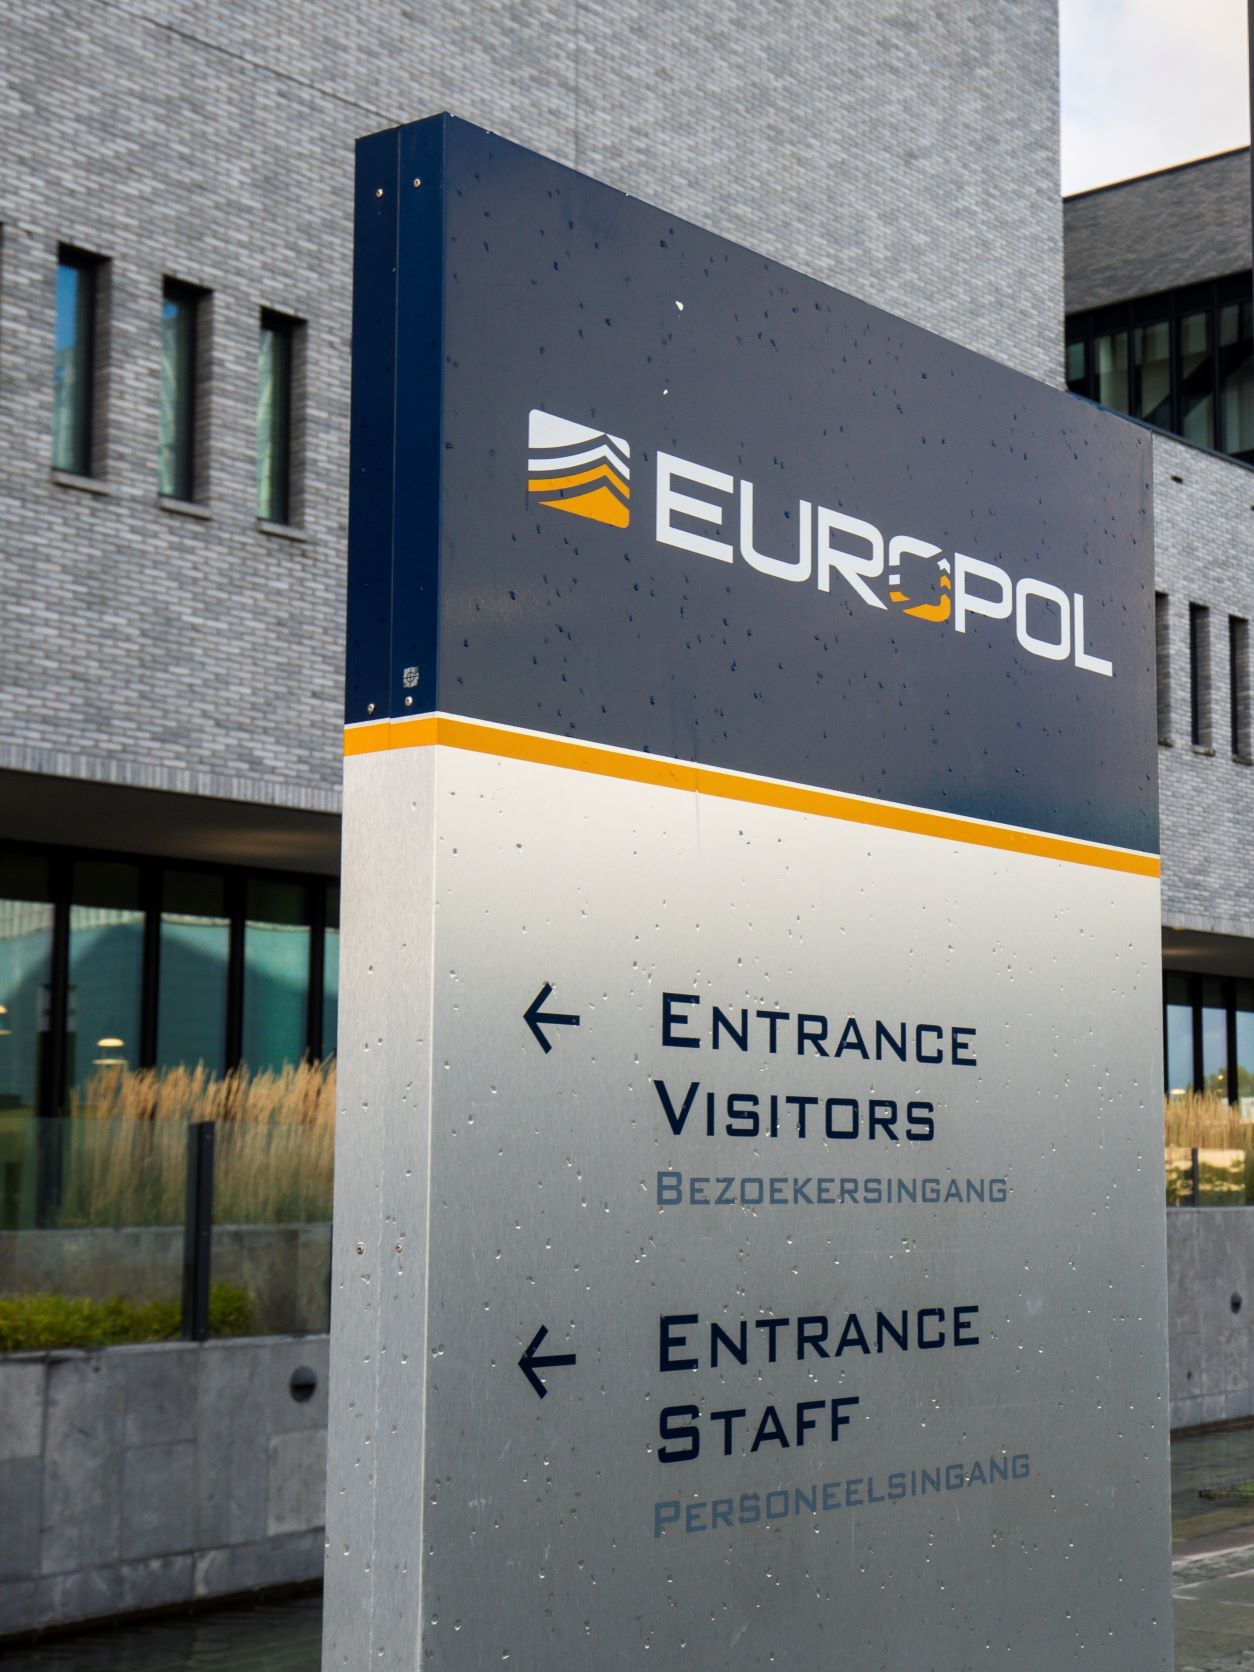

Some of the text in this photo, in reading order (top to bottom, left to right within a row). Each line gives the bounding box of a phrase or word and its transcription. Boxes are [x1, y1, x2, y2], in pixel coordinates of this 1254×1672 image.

[656, 450, 1113, 677] EUROPOL
[661, 991, 977, 1067] ENTRANCE
[653, 1079, 935, 1142] VISITORS
[659, 1305, 980, 1373] ENTRANCE
[657, 1396, 860, 1464] STAFF
